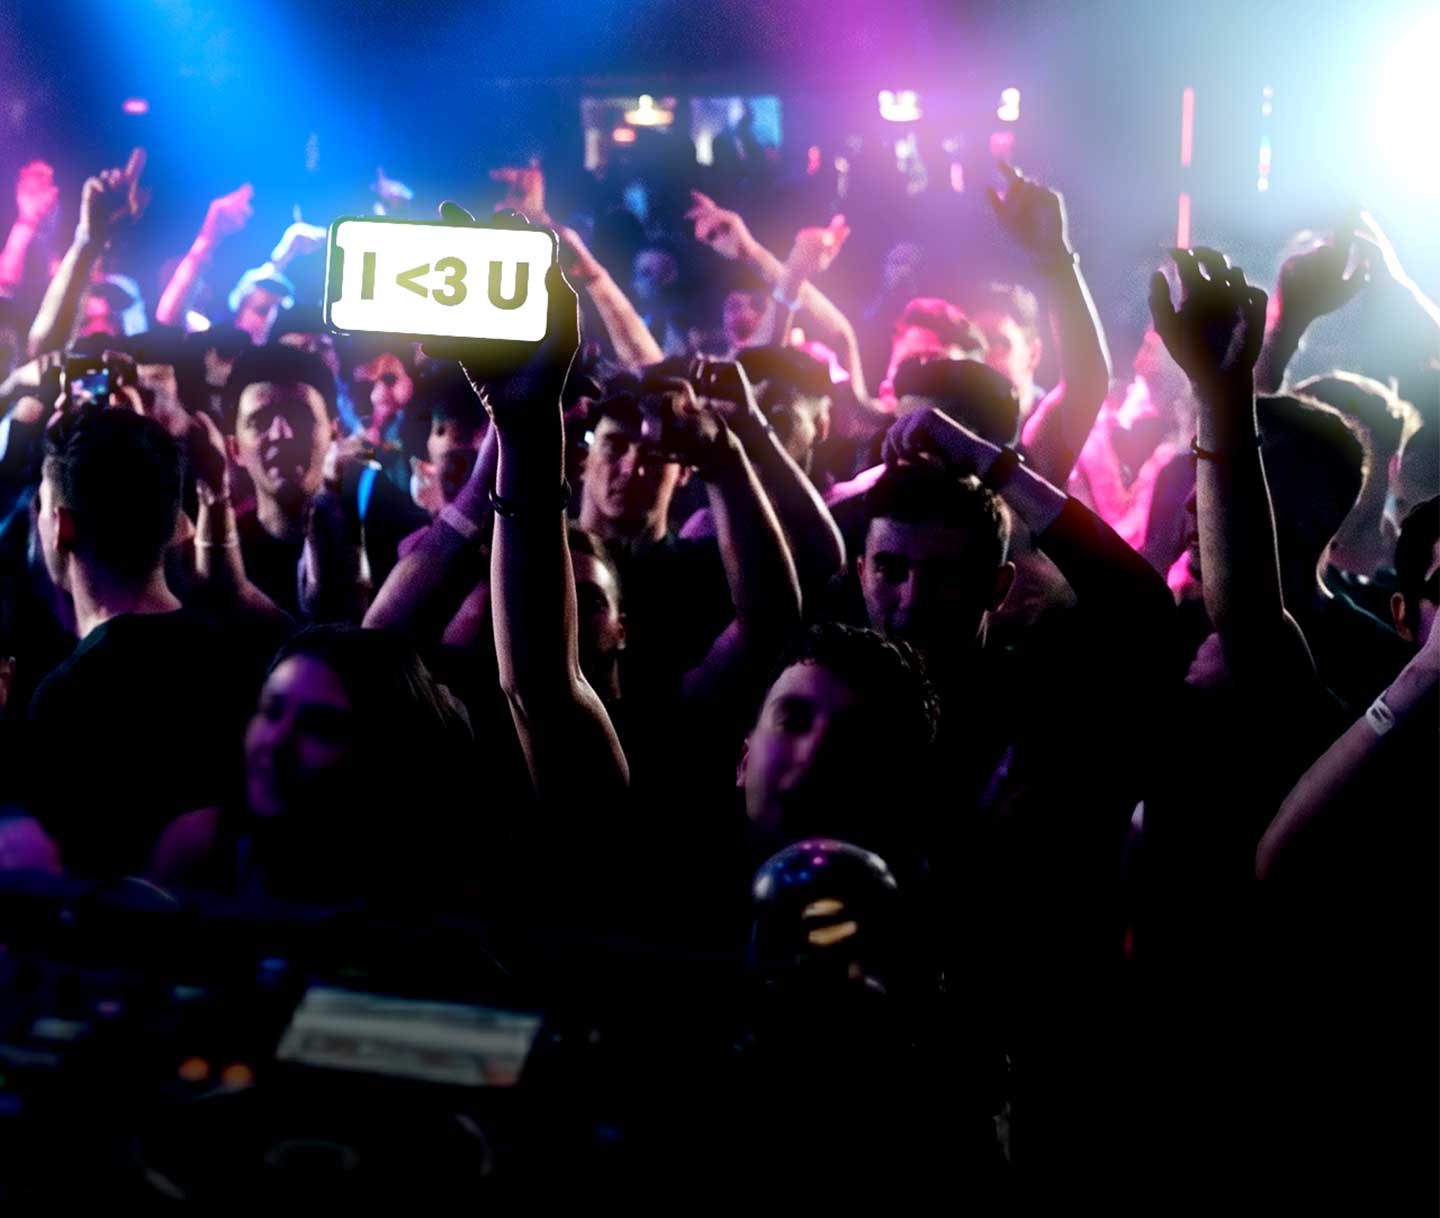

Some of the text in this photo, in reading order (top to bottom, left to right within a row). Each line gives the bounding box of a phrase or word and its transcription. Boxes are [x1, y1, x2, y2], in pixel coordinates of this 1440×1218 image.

[361, 252, 529, 310] I <3 U
